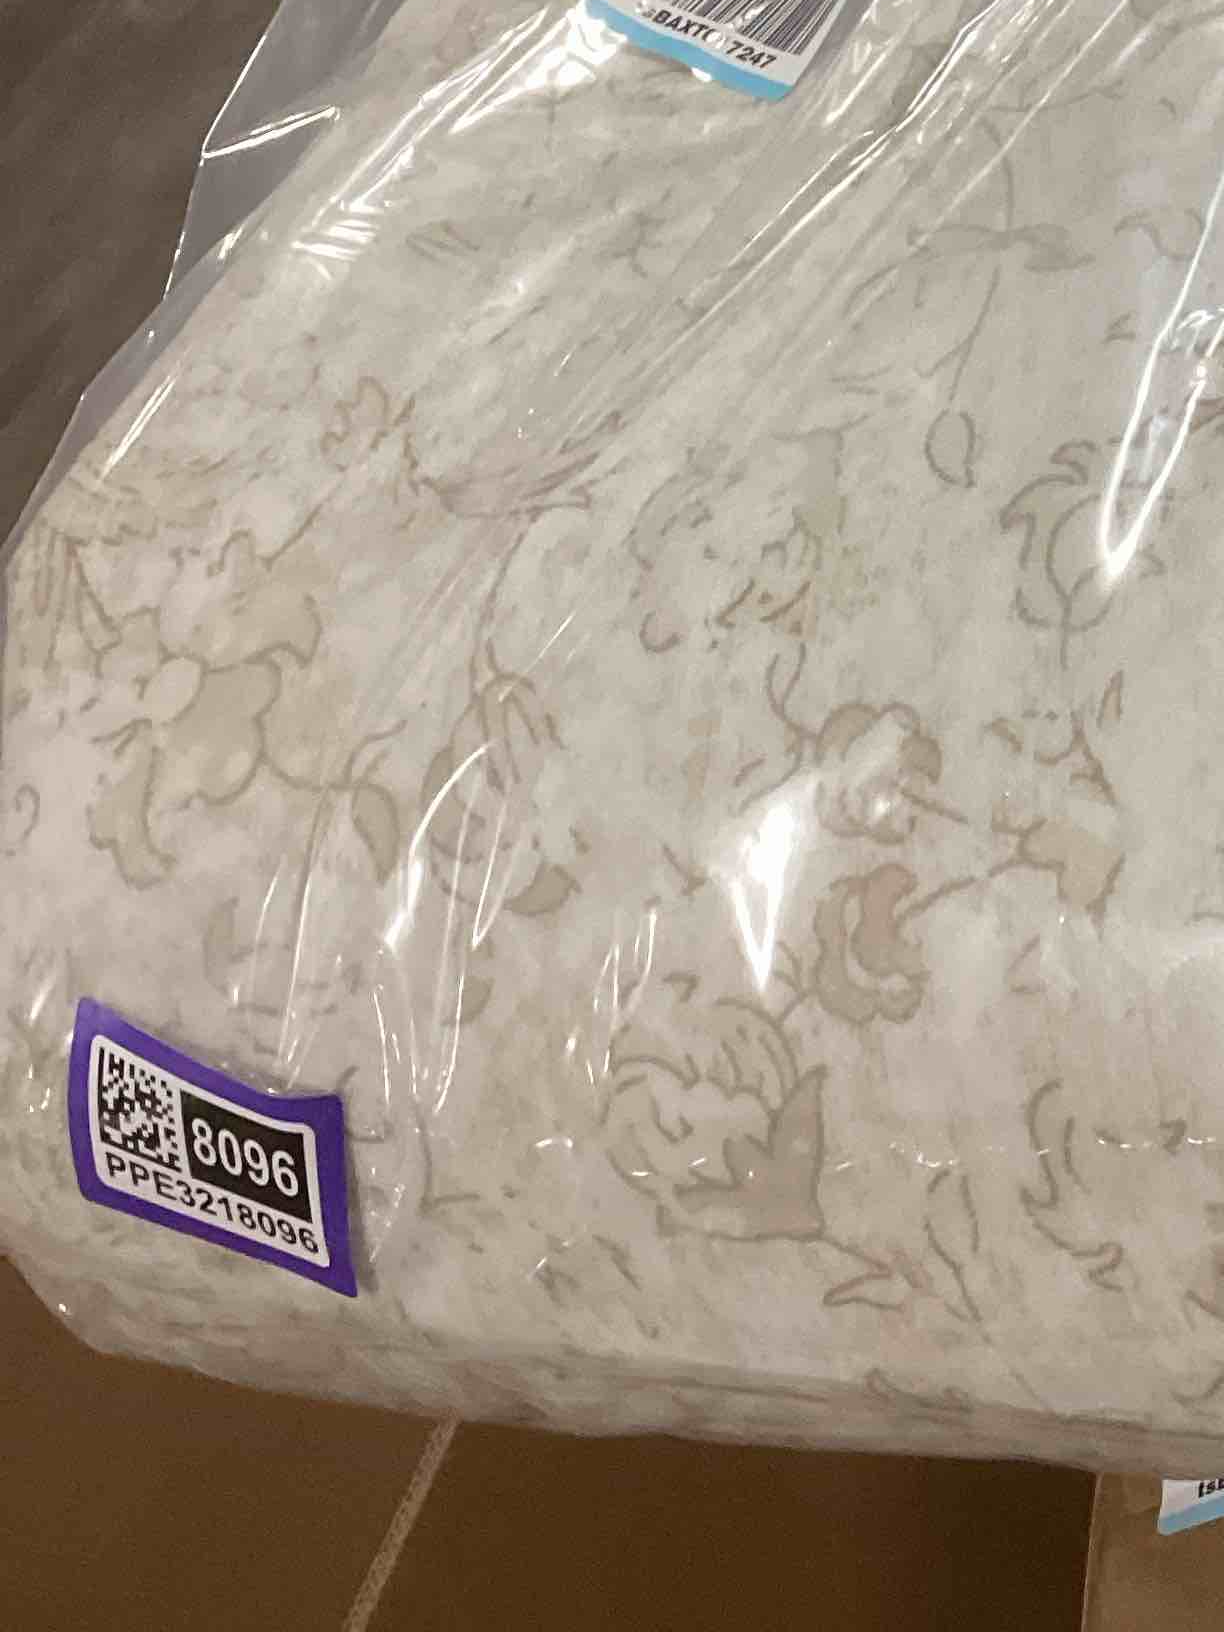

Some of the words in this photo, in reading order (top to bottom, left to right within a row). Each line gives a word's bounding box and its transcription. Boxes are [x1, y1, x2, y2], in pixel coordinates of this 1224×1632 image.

[726, 40, 777, 69] 7247
[191, 1117, 300, 1198] 8096
[104, 1150, 320, 1254] PPE3218096
